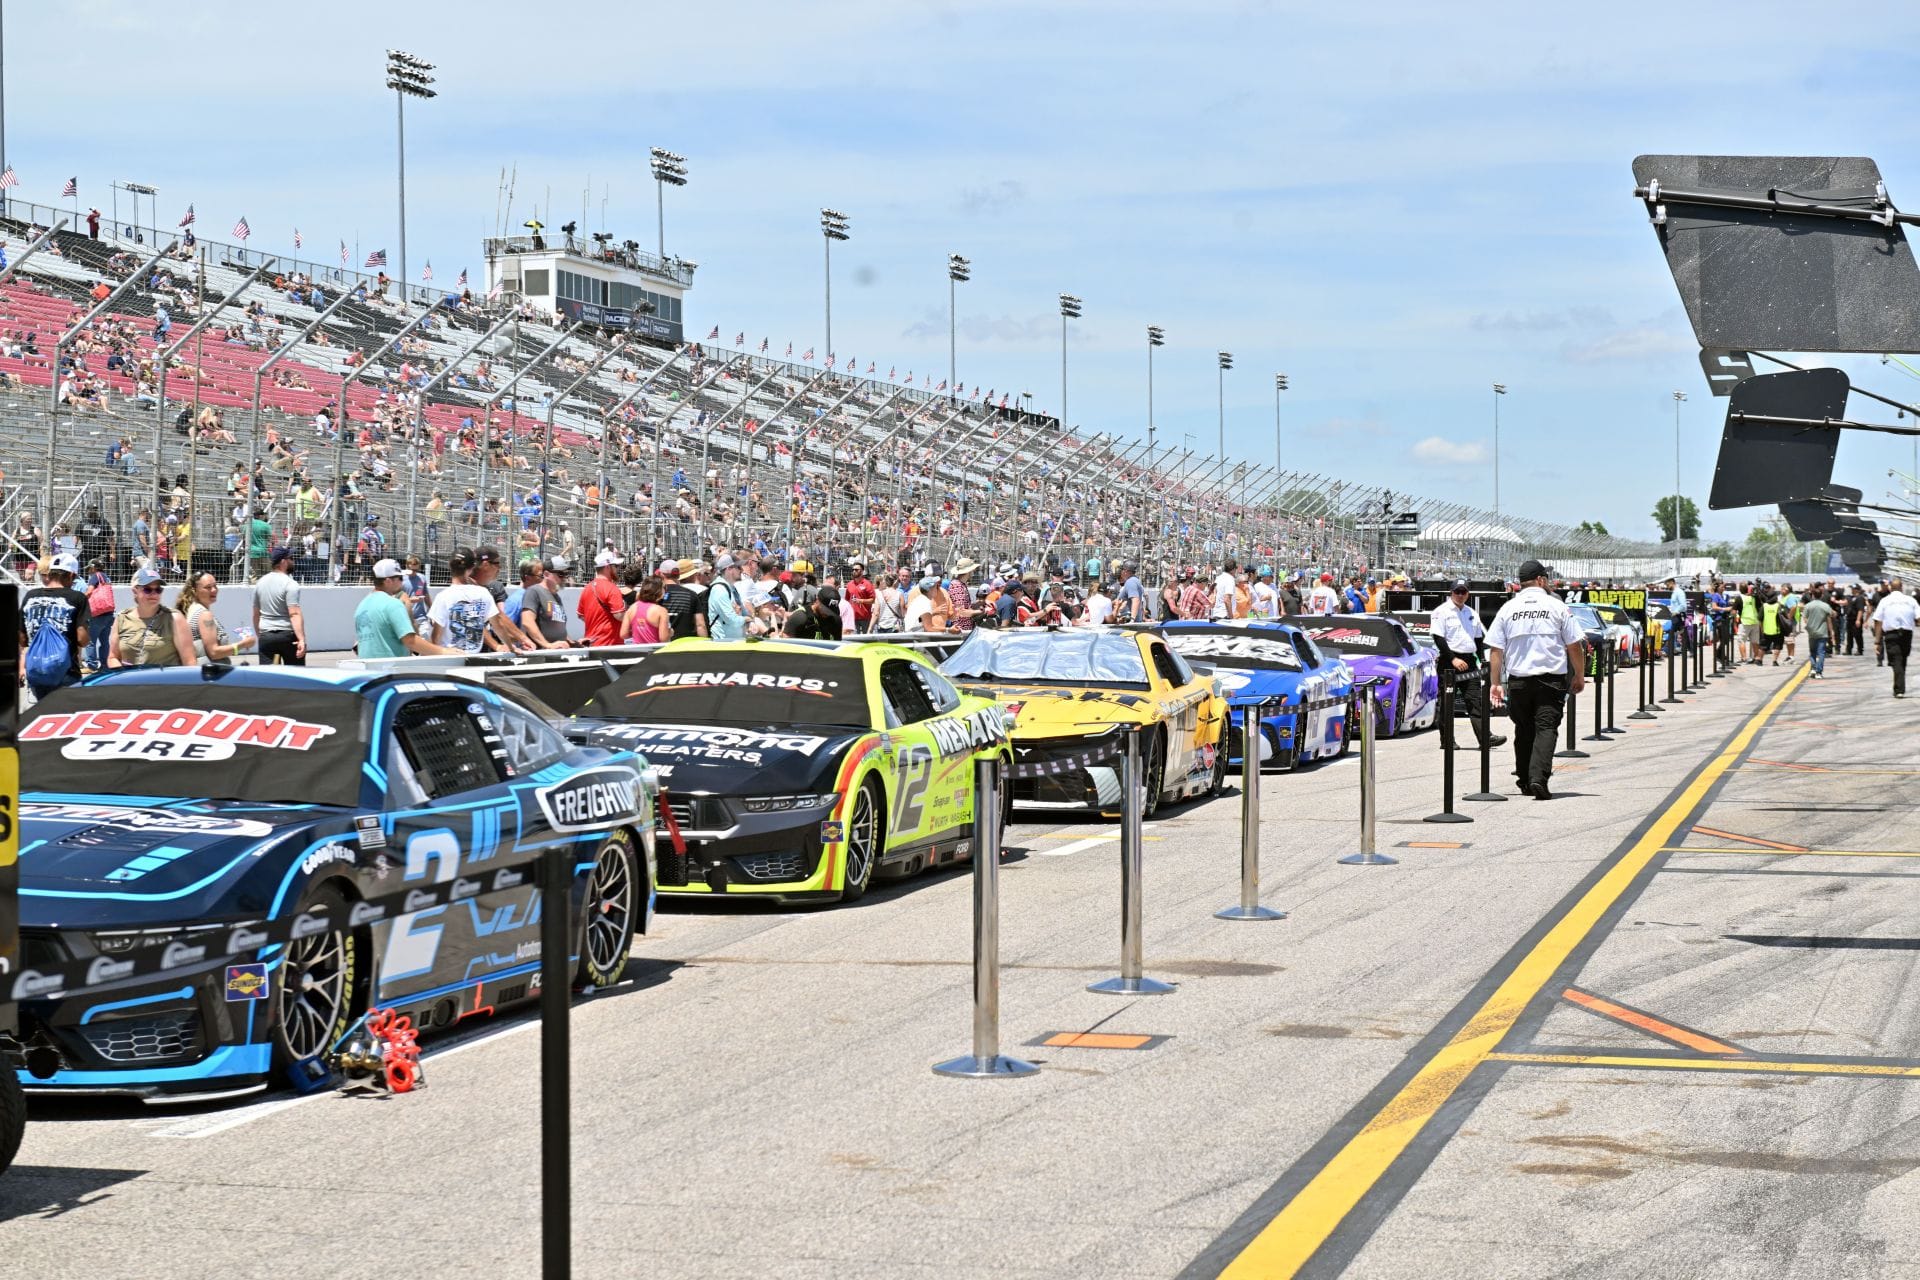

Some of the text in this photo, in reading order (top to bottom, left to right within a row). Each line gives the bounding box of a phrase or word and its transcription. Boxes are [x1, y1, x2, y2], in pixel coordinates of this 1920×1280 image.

[1512, 610, 1551, 621] OFFICIAL
[1565, 590, 1645, 610] 24 RAPTOR
[646, 672, 824, 691] MENARDS
[20, 710, 325, 748] DISCOUNT
[926, 704, 1005, 756] MENARD
[88, 740, 212, 759] TIRE
[634, 744, 762, 763] HEATERS
[555, 779, 636, 824] FREIGHTLI
[888, 744, 933, 836] 12
[302, 840, 357, 875] GOODYEAR
[379, 827, 461, 986] 2
